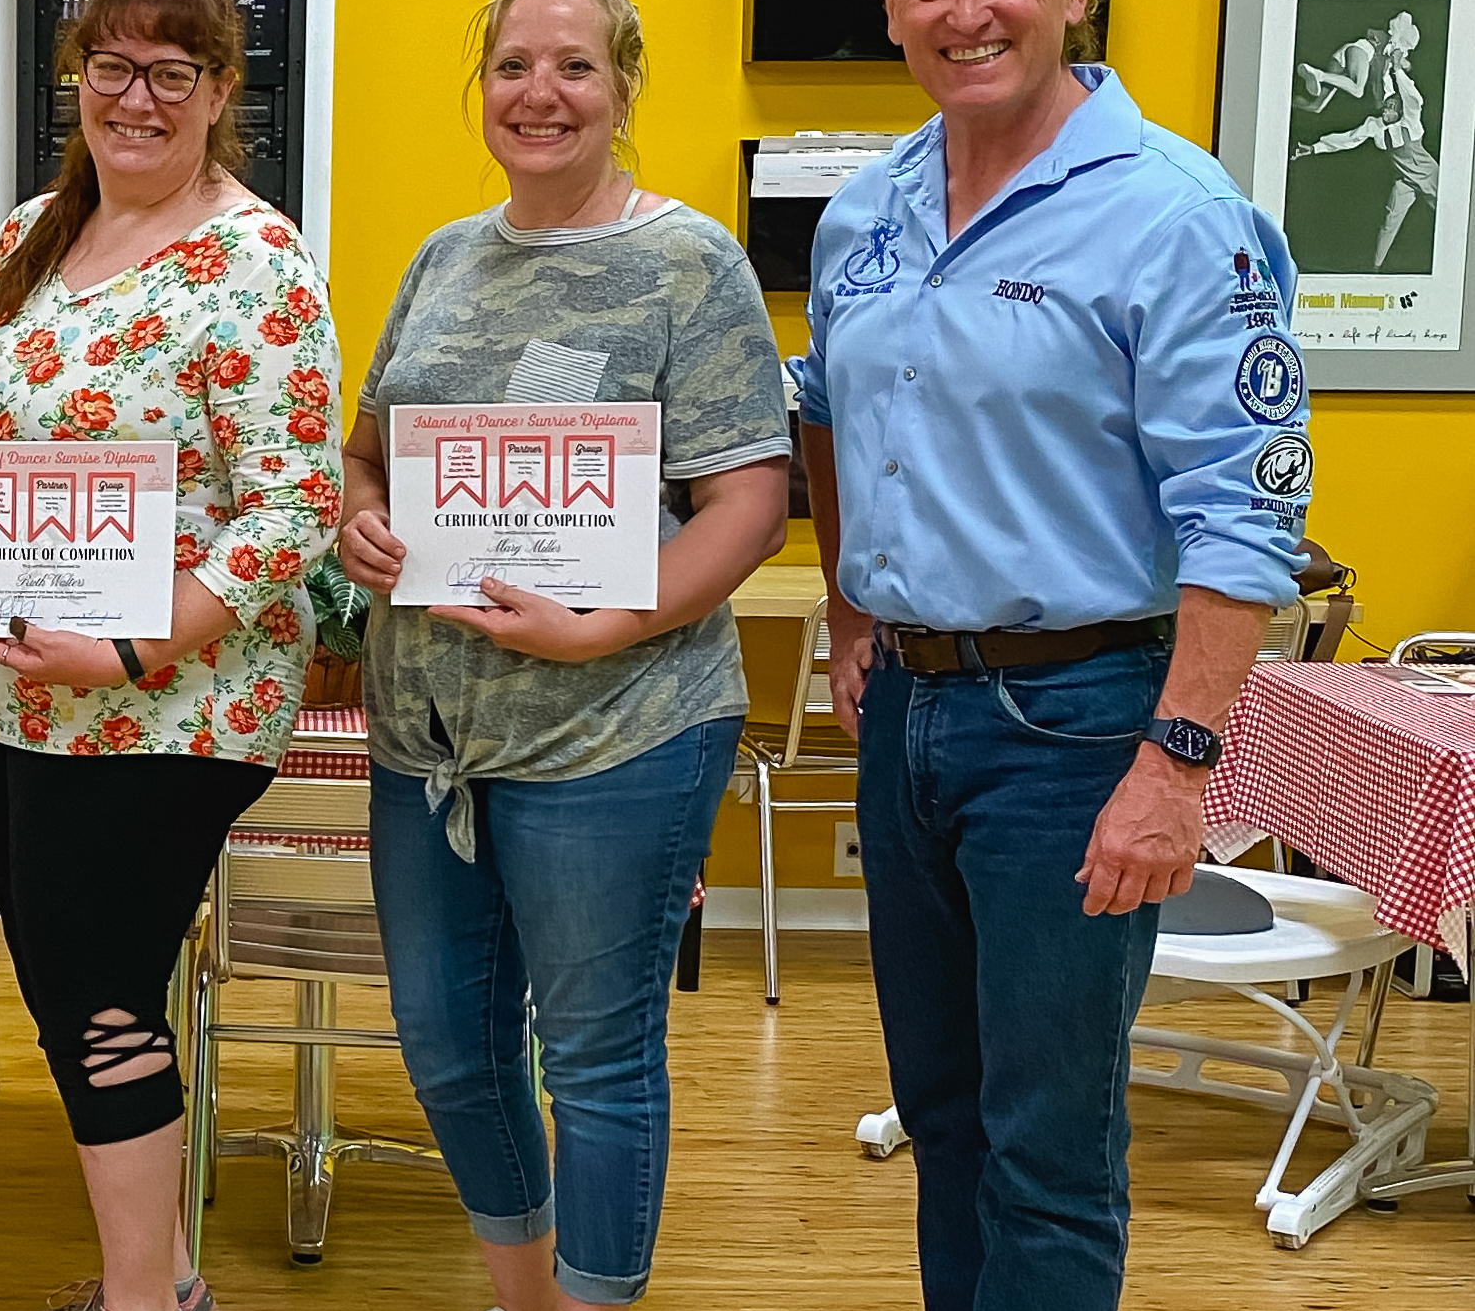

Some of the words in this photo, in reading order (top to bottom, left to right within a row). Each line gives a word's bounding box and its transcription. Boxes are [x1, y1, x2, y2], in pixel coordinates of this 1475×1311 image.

[992, 279, 1045, 304] HONDO
[1297, 293, 1335, 308] Frankie
[1340, 293, 1395, 311] Manning's
[412, 415, 457, 429] Island
[459, 414, 473, 432] of
[527, 413, 577, 427] Sunrise
[580, 412, 639, 430] Diploma
[507, 443, 543, 454] Partner
[575, 443, 603, 455] Group
[55, 451, 100, 464] Sunrise
[104, 451, 157, 467] Diploma
[35, 479, 68, 490] Partner
[97, 480, 125, 492] Group
[434, 513, 511, 528] CERTIFICATE
[514, 513, 529, 527] OF
[534, 513, 616, 528] COMPLETION
[486, 539, 521, 554] Mary
[525, 538, 562, 553] Miller
[41, 547, 55, 561] OF
[59, 547, 135, 561] COMPLETION
[15, 572, 47, 588] Ruth
[47, 572, 86, 588] Walters
